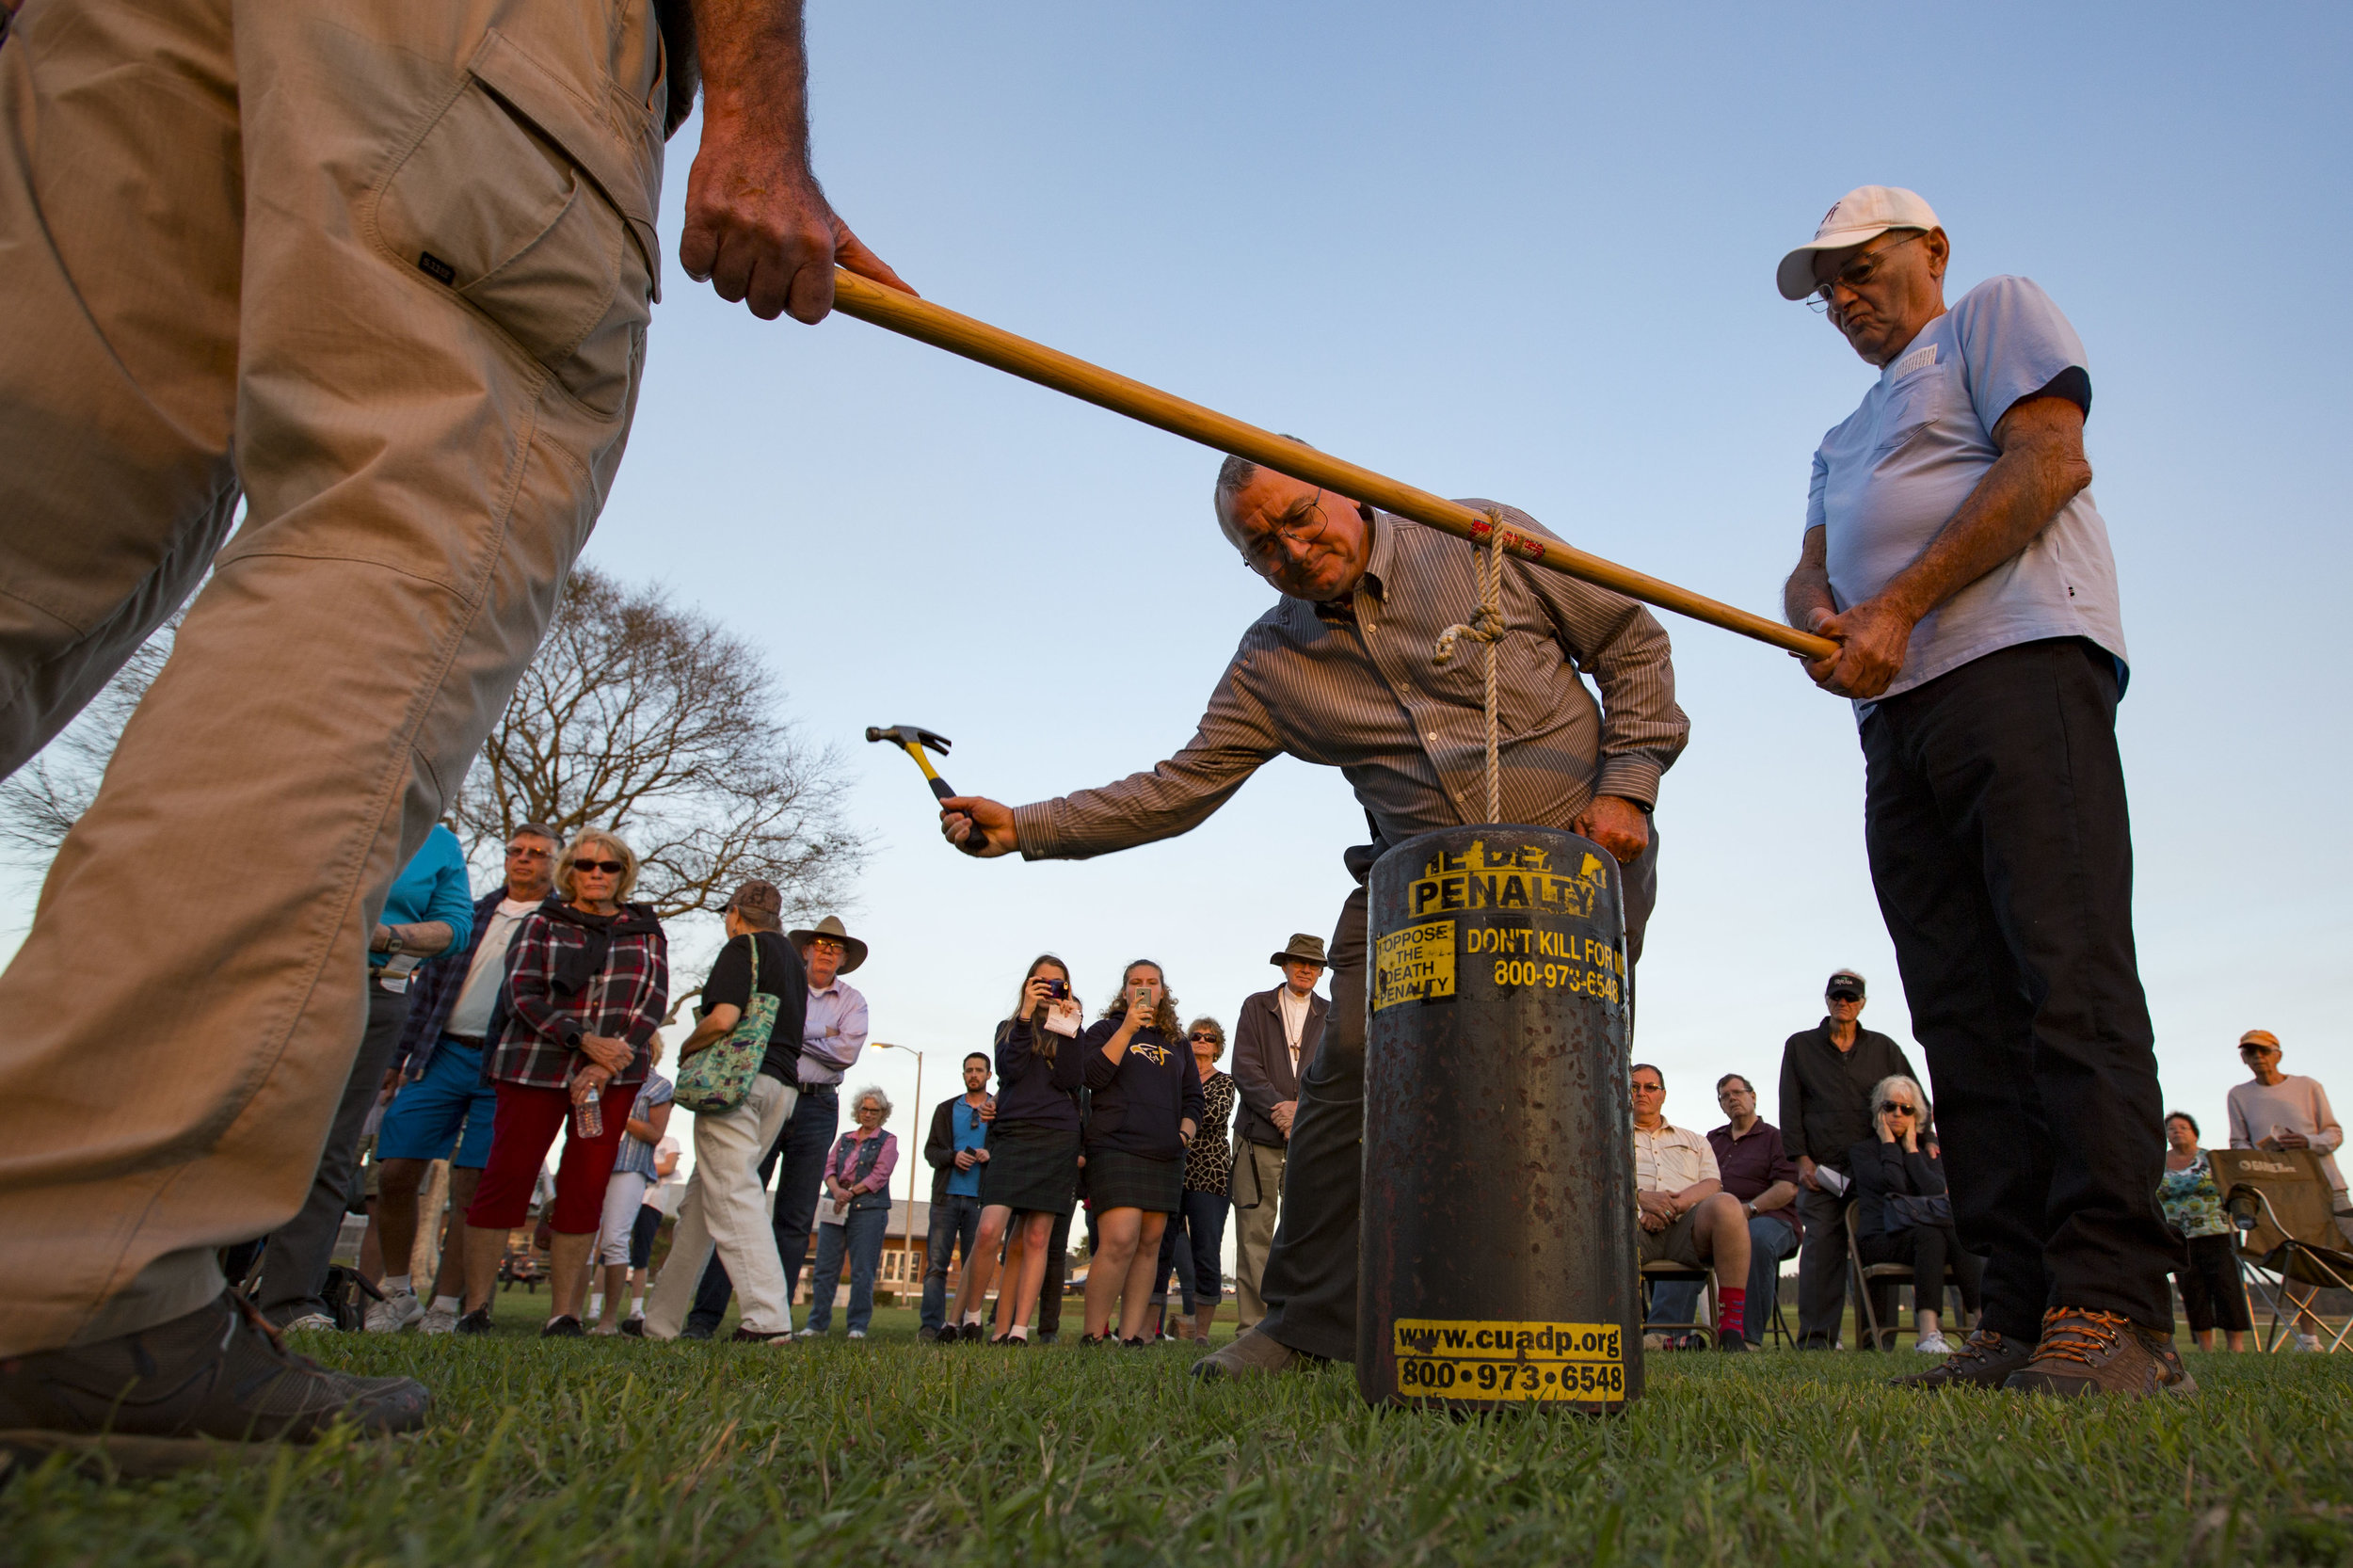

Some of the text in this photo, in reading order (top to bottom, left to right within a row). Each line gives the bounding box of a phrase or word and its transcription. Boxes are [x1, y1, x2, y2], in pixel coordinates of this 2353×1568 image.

[1416, 874, 1593, 916] PENALTY
[1385, 925, 1448, 952] OPPOSE
[1467, 928, 1534, 953] DON'T
[1539, 931, 1581, 961] KILL
[1585, 938, 1613, 971] FOR
[1396, 946, 1423, 964] THE
[1385, 961, 1433, 985] DEATH
[1495, 960, 1619, 1004] 800-973-6548
[1380, 977, 1449, 1005] PENALTY
[1399, 1325, 1620, 1358] www.cuadp.org
